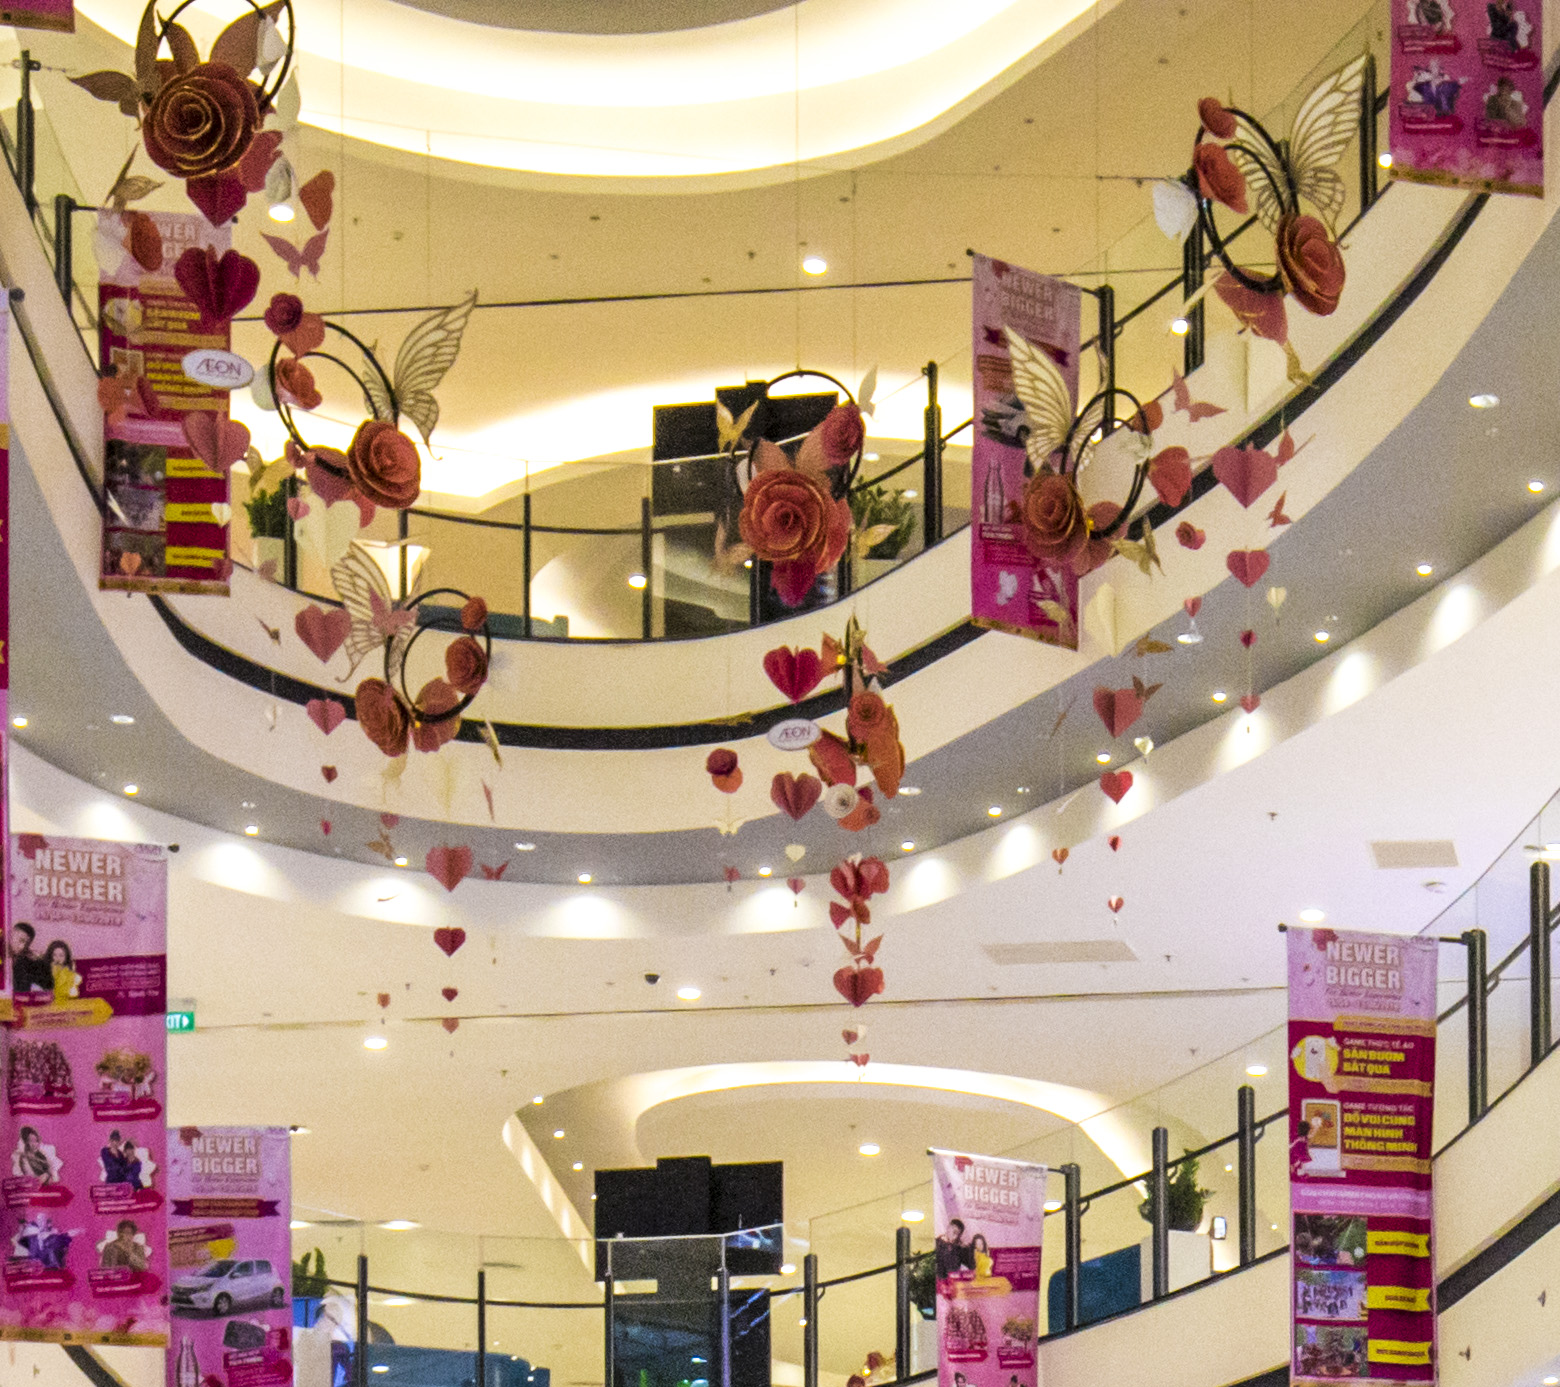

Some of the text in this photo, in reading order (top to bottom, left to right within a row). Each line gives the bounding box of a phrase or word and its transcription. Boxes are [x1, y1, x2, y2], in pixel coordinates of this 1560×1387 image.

[34, 848, 122, 877] NEWER
[33, 873, 124, 903] BIGGER
[1325, 940, 1400, 965] NEWER
[1325, 964, 1401, 990] BIGGER
[191, 1136, 258, 1154] NEWER
[191, 1156, 258, 1174] BIGGER
[963, 1163, 1019, 1188] NEWER
[964, 1184, 1019, 1207] BIGGER
